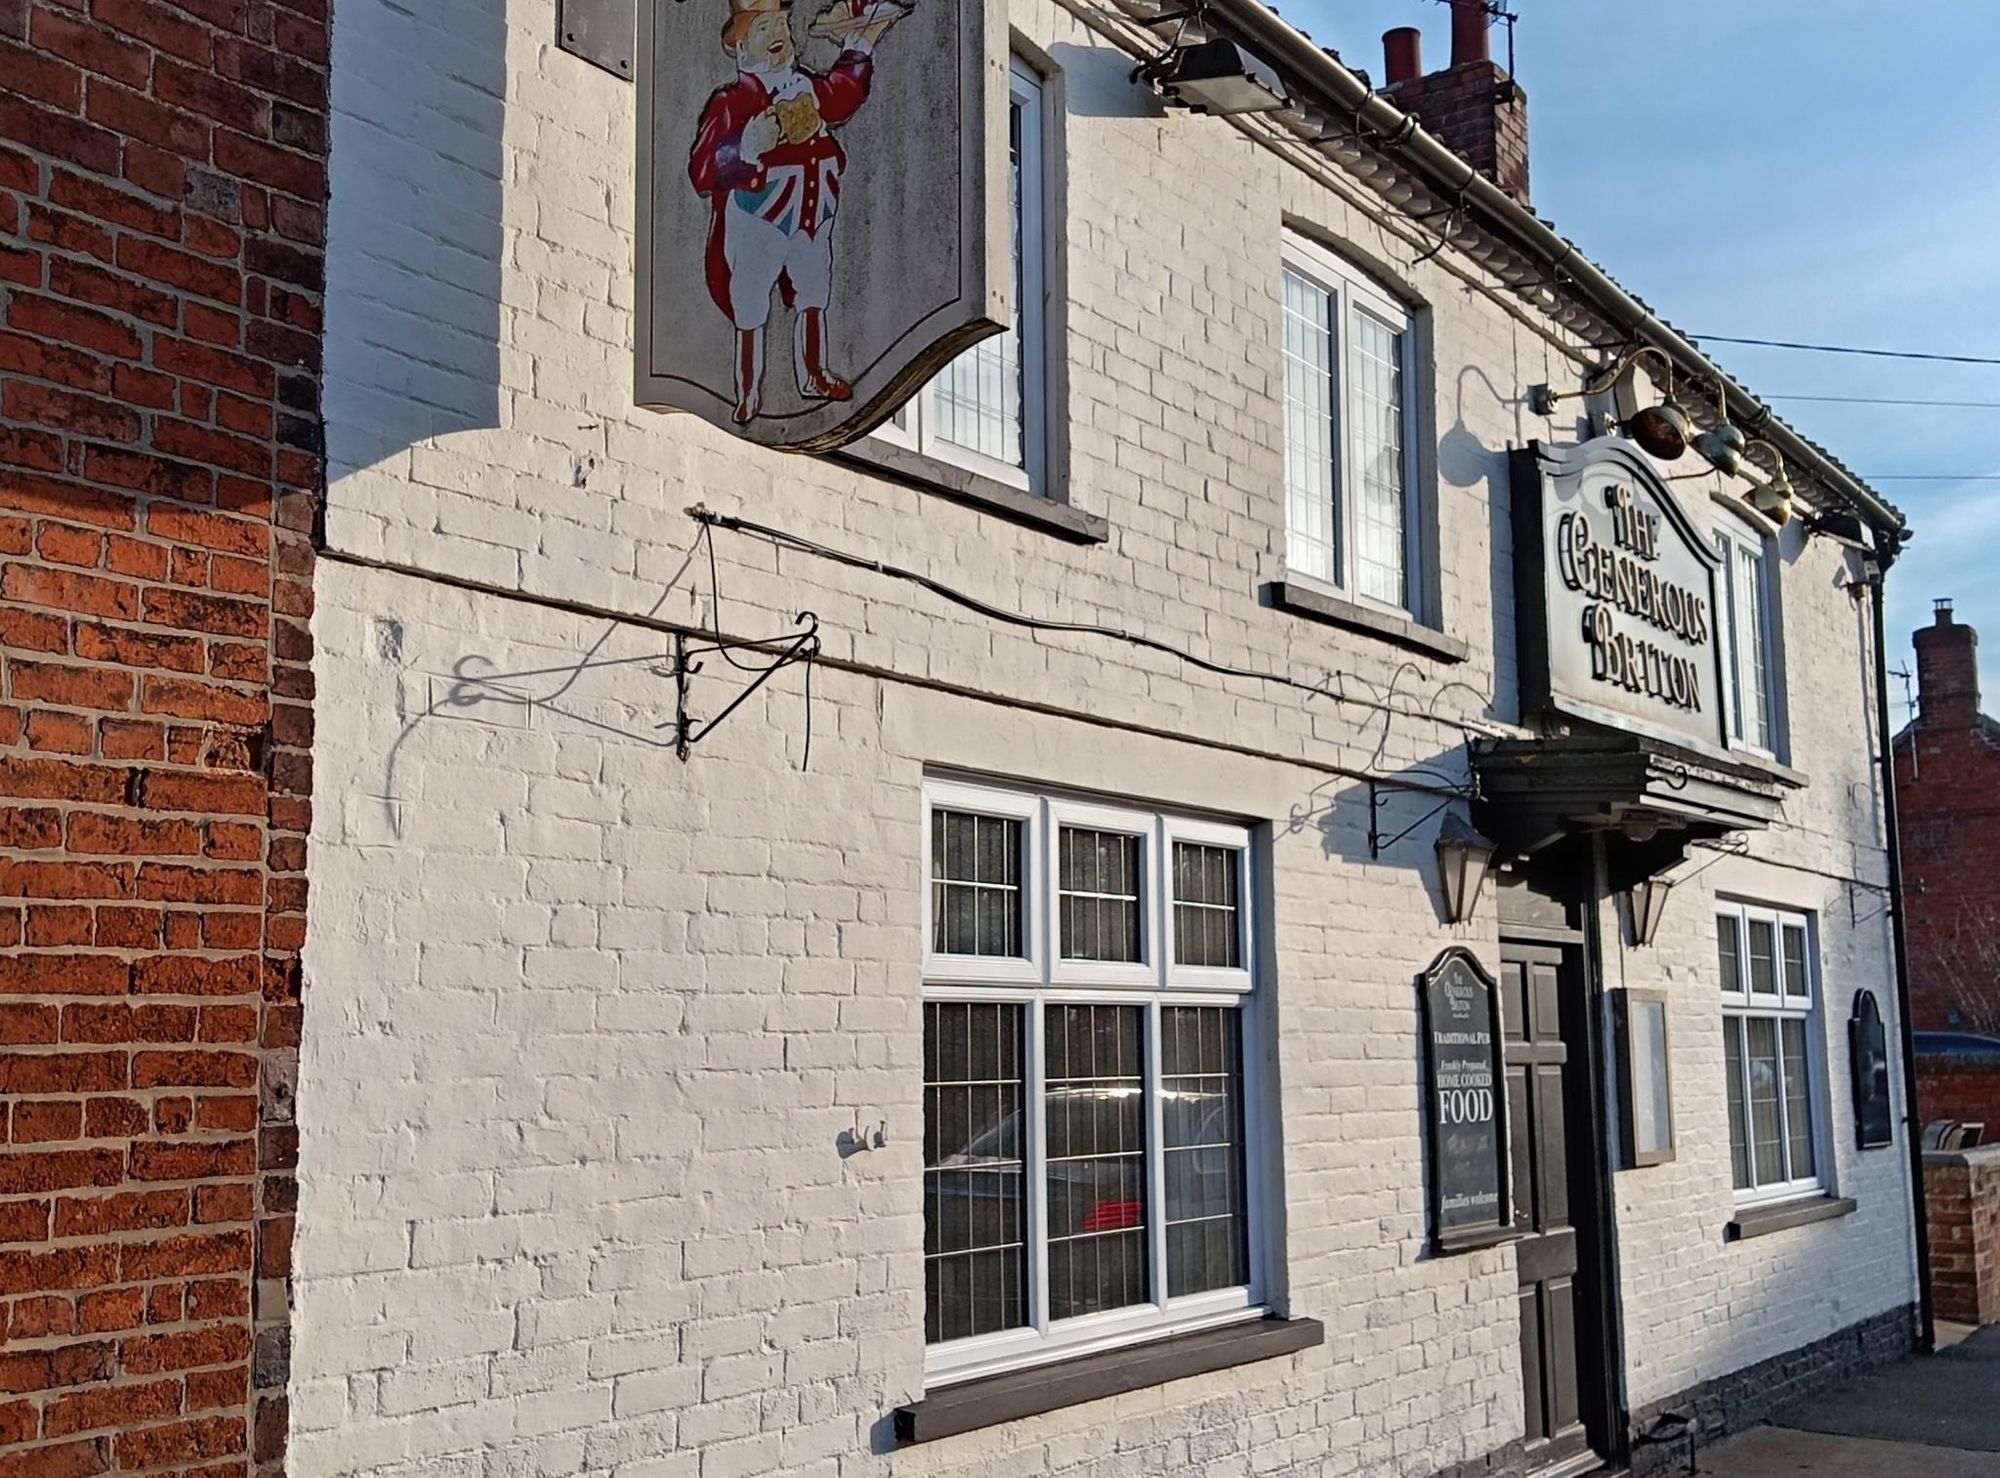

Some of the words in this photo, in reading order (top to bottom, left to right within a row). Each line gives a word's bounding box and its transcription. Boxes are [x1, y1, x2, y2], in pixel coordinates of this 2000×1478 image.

[1606, 484, 1661, 561] THE
[1558, 510, 1708, 646] GENEROUS
[1582, 604, 1701, 713] BRITON
[1434, 1031, 1476, 1045] TRADITIONAL
[1477, 1031, 1491, 1045] PUB
[1437, 1074, 1460, 1089] HOME
[1461, 1073, 1493, 1088] COOKED
[1438, 1088, 1493, 1125] FOOD
